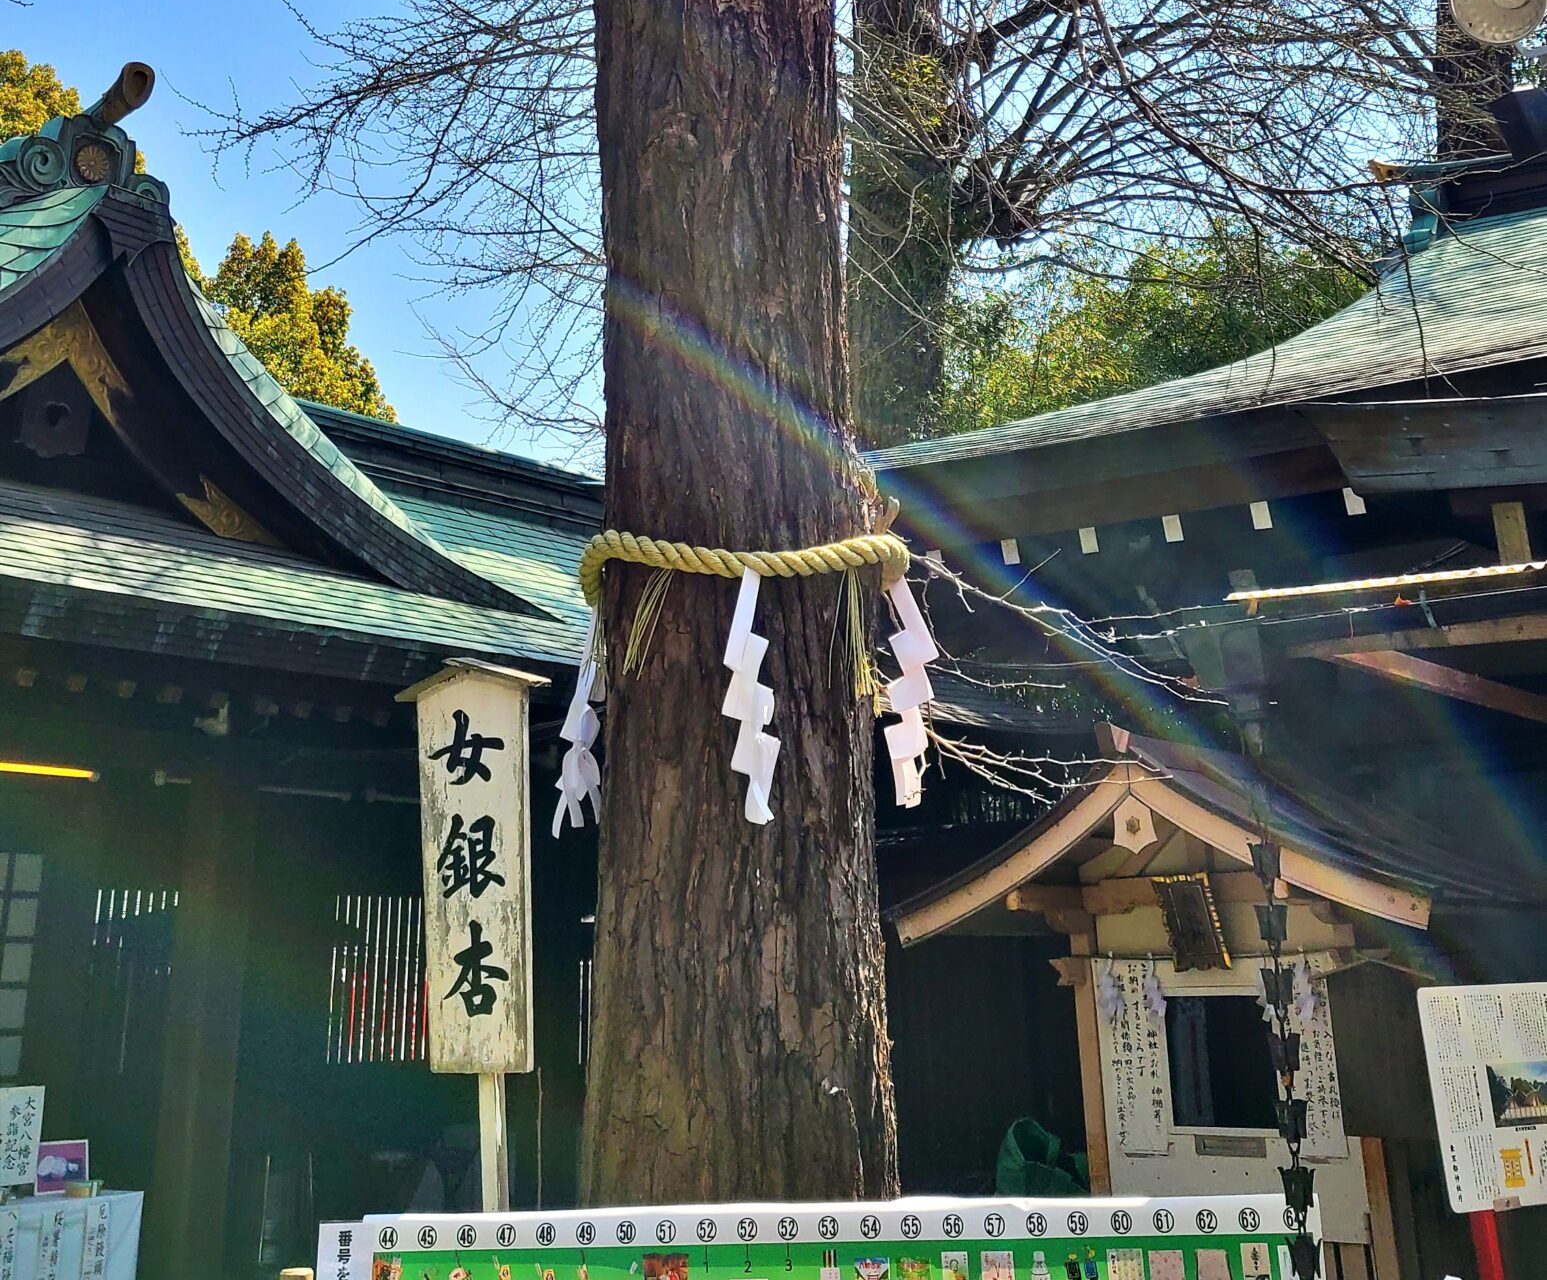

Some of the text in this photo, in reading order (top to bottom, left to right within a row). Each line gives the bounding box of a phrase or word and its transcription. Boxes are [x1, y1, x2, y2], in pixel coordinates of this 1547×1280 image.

[428, 709, 509, 1017] 女銀杏
[2, 1105, 21, 1170] 参詣記念
[17, 1097, 36, 1176] 大宮八幡宮
[378, 1228, 396, 1248] 44
[419, 1227, 435, 1247] 45
[458, 1226, 475, 1246] 46
[498, 1225, 514, 1245] 47
[537, 1224, 554, 1244] 48
[577, 1223, 594, 1243] 49
[618, 1222, 634, 1242] 50
[658, 1222, 673, 1242] 51
[698, 1220, 715, 1240] 52
[739, 1219, 756, 1240] 52
[779, 1219, 796, 1238] 52
[820, 1218, 838, 1238] 53
[862, 1217, 879, 1237] 54
[902, 1217, 920, 1237] 55
[944, 1216, 962, 1236] 56
[986, 1216, 1003, 1236] 57
[1027, 1214, 1046, 1234] 58
[1069, 1213, 1087, 1234] 59
[1112, 1212, 1131, 1233] 60
[1154, 1211, 1171, 1231] 61
[1197, 1211, 1215, 1231] 62
[1240, 1209, 1258, 1230] 63
[337, 1230, 353, 1280] 番号を
[744, 1260, 753, 1273] 2
[784, 1259, 793, 1272] 3
